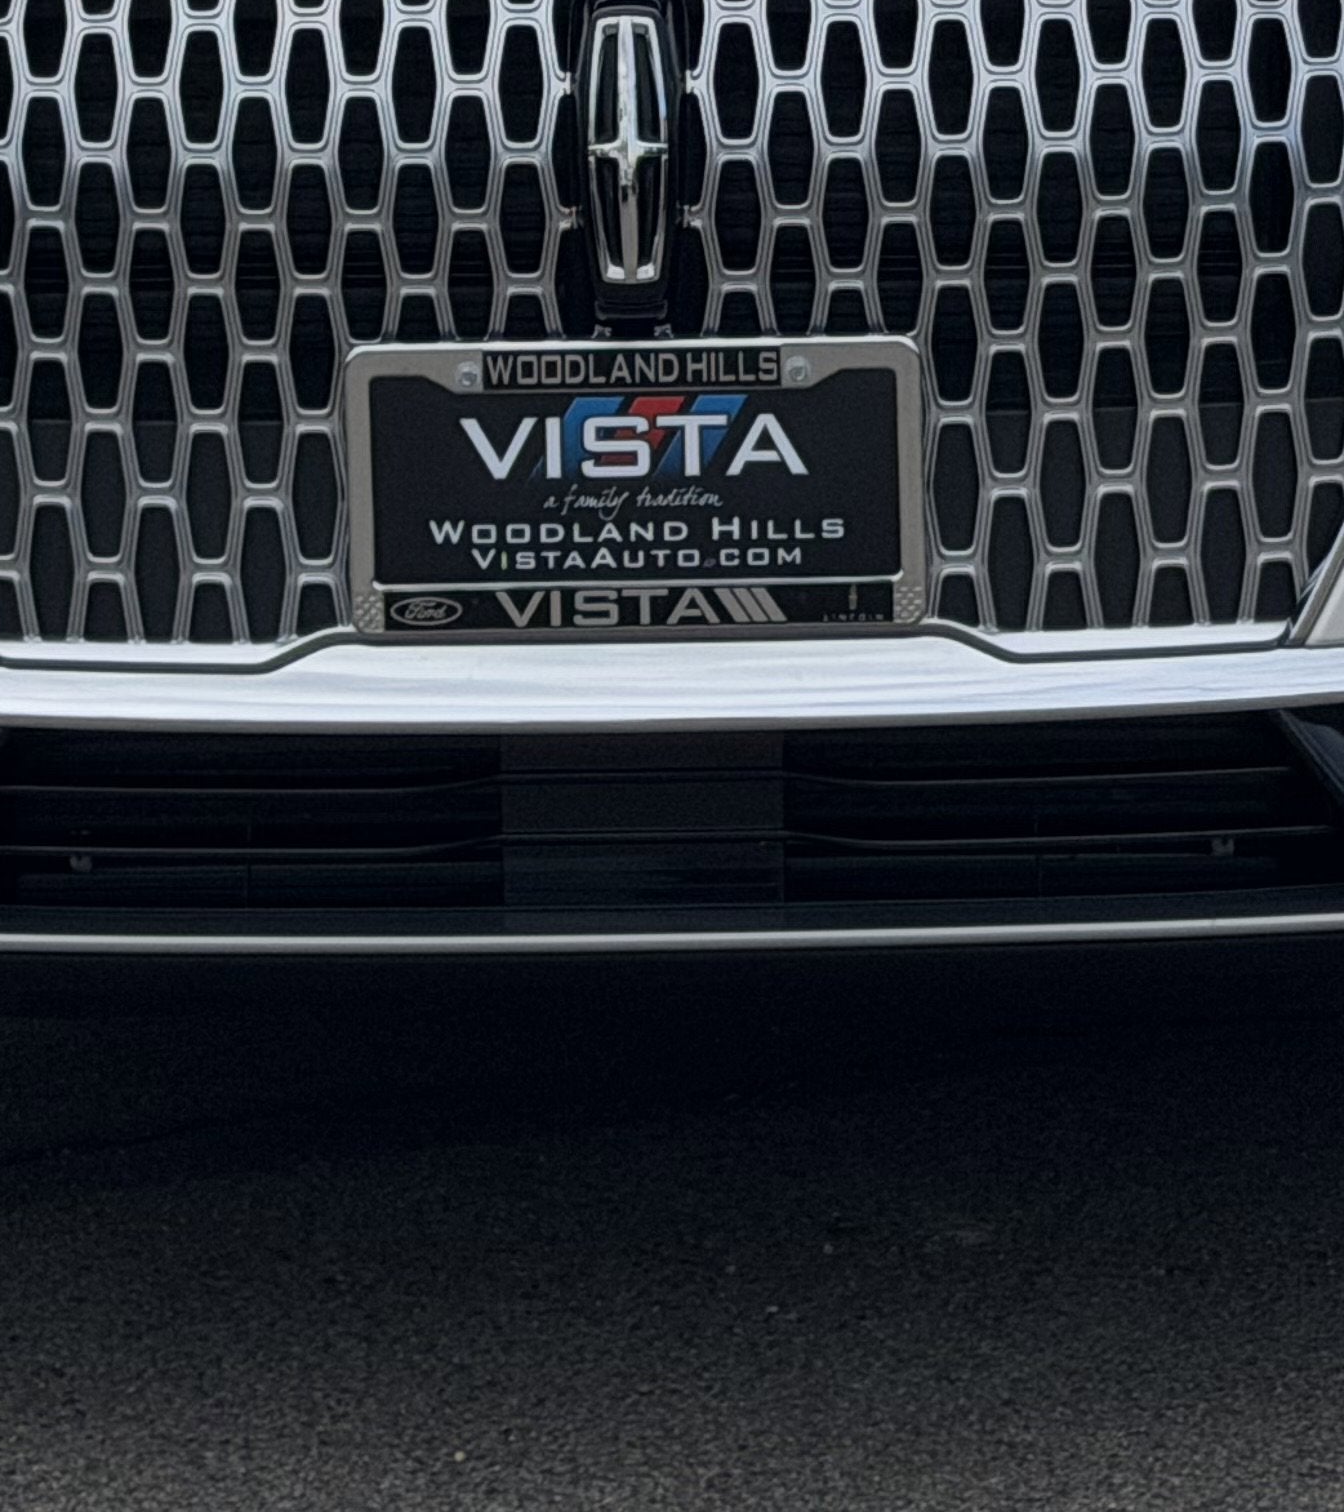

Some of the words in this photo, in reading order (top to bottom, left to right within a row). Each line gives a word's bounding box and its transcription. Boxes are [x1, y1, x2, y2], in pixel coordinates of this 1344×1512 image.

[486, 351, 679, 387] WOODLAND
[687, 349, 779, 384] HILLS
[458, 412, 810, 480] VISTA
[543, 495, 558, 508] a
[560, 484, 631, 521] family
[636, 485, 724, 508] tradition
[429, 519, 689, 545] WOODLAND
[711, 516, 846, 540] HILLS
[495, 587, 721, 628] VISTA
